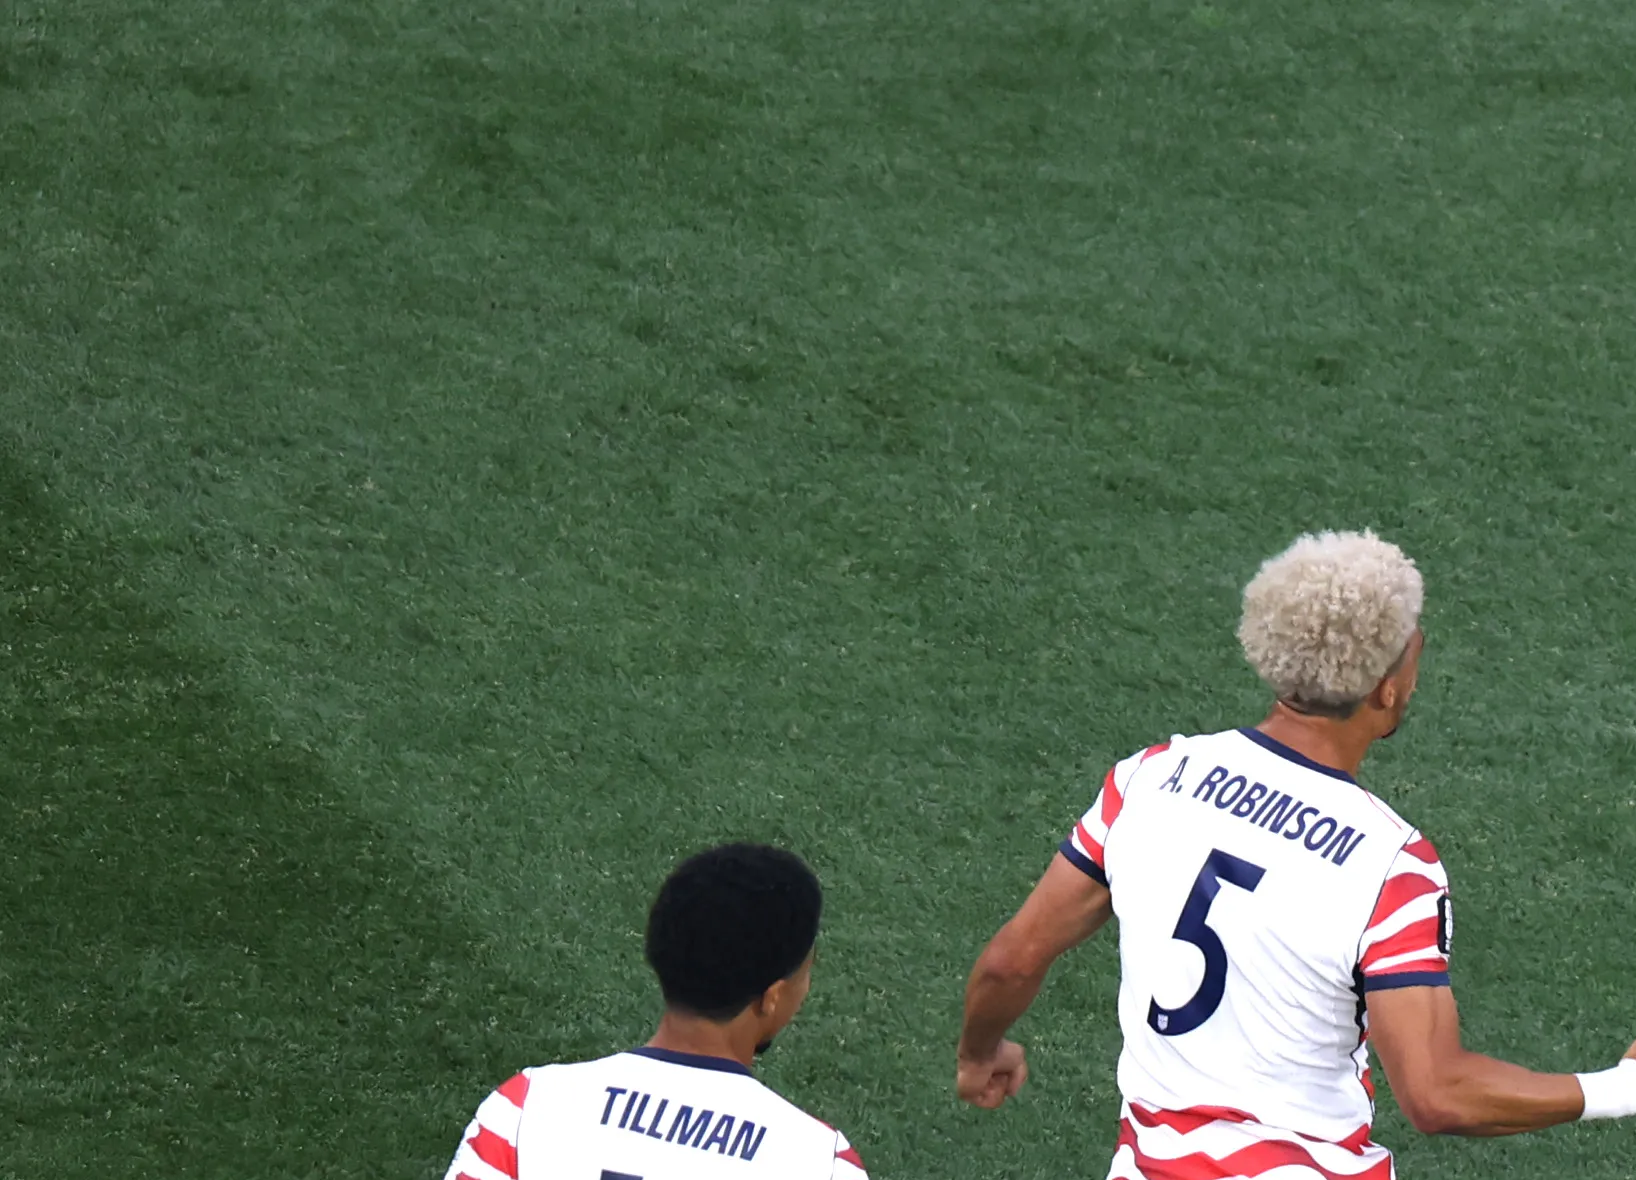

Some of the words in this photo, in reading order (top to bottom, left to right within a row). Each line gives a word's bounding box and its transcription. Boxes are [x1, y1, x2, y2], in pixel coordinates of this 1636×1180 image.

[1160, 755, 1189, 794] A.
[1193, 766, 1365, 866] ROBINSON
[1147, 848, 1267, 1036] 5
[600, 1086, 767, 1161] TILLMAN
